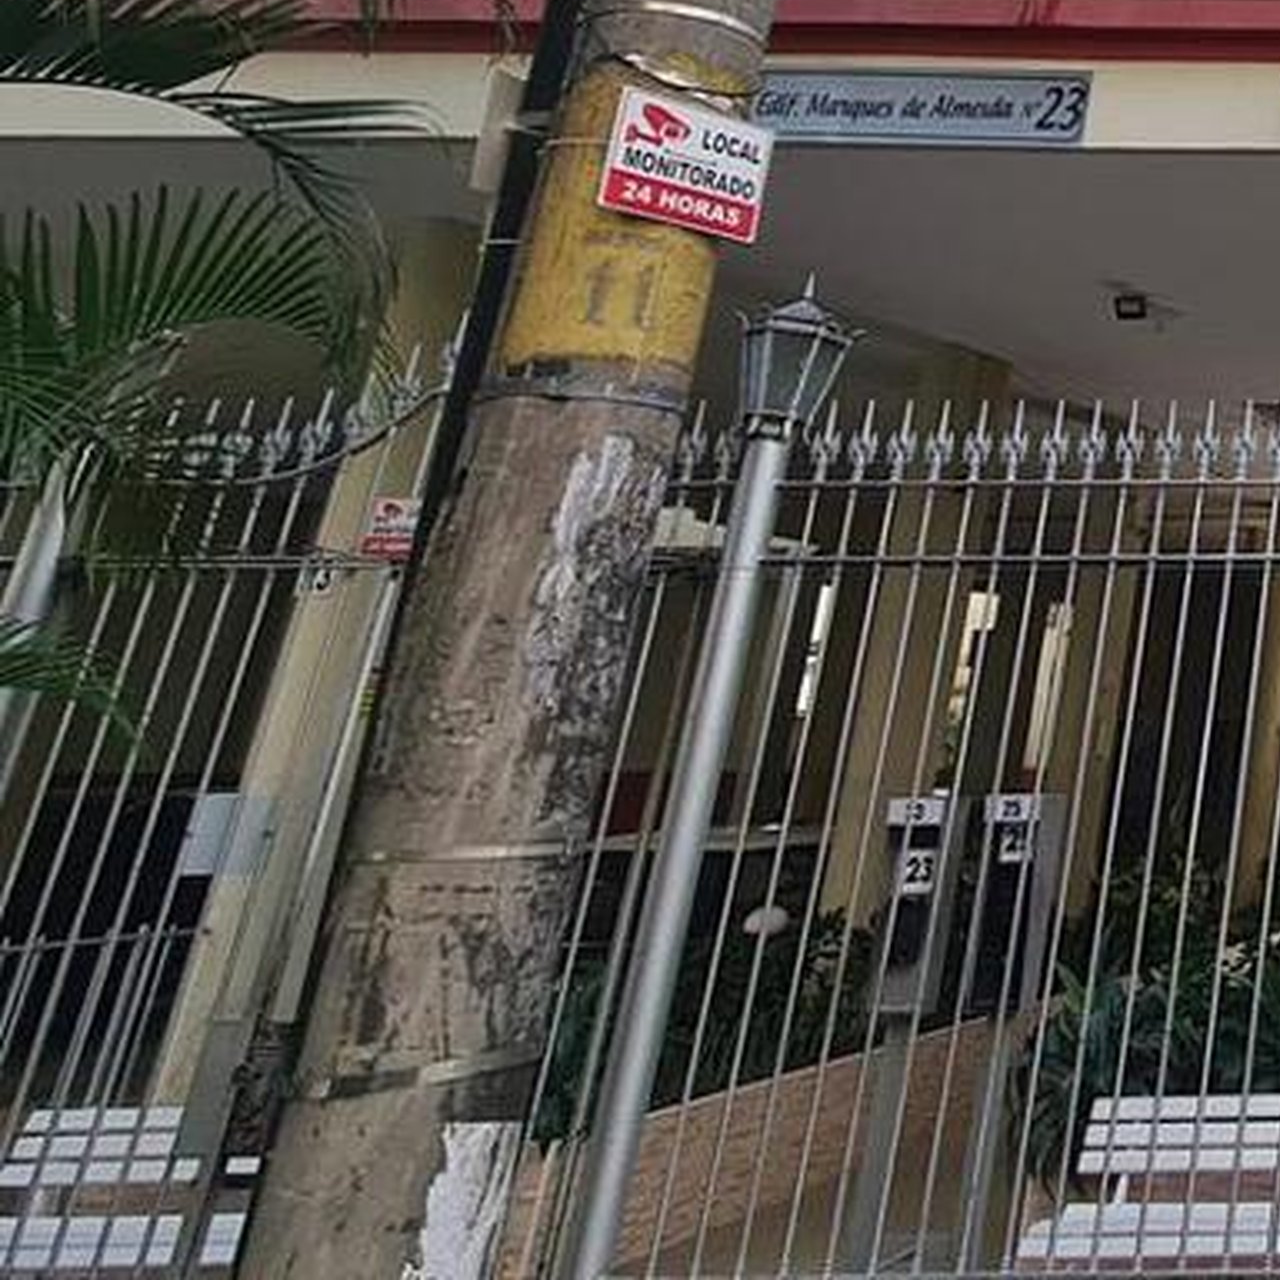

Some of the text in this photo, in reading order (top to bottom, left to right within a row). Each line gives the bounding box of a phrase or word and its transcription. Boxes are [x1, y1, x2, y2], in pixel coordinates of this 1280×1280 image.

[902, 94, 927, 119] de
[1034, 85, 1087, 131] 23
[701, 128, 761, 165] LOCAL
[623, 147, 756, 200] MONITORADO
[621, 181, 742, 226] 24 HORAS
[905, 855, 934, 884] 23
